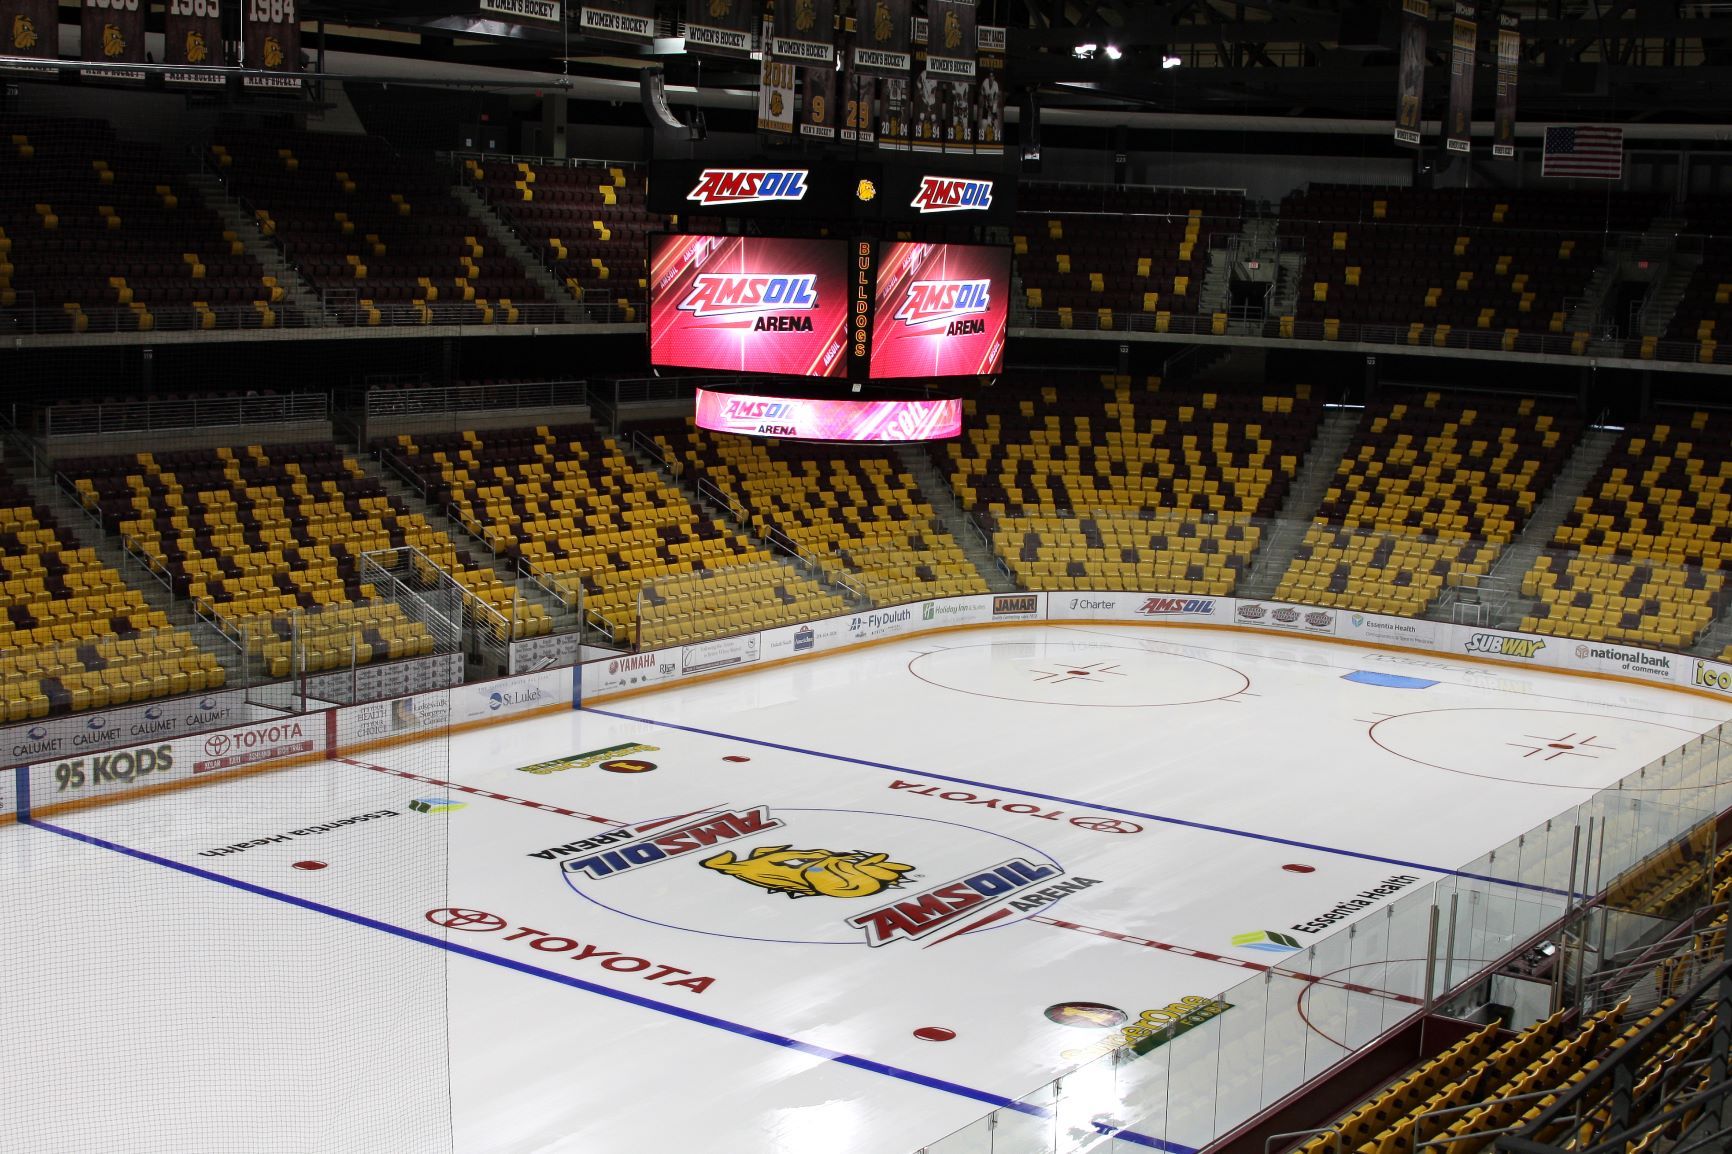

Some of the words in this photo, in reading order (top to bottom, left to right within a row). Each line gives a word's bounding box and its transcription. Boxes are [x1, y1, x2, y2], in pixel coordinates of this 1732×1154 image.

[249, 0, 295, 24] 1984
[524, 1, 555, 18] HOCKEY
[586, 11, 620, 28] WOMEN'S
[621, 16, 649, 33] HOCKEY
[689, 26, 721, 43] WOMEN'S
[721, 30, 746, 47] HOCKEY
[777, 40, 806, 57] WOMEN'S
[806, 42, 829, 58] HOCKEY
[858, 50, 883, 66] WOMEN'S
[883, 52, 906, 67] HOCKEY
[763, 61, 794, 89] 2011
[930, 58, 953, 72] WOMEN'S
[953, 60, 973, 74] HOCKEY
[812, 95, 825, 123] 9
[847, 100, 869, 128] 29
[690, 170, 807, 204] AMSOIL
[912, 176, 993, 212] AMSOIL
[659, 267, 679, 290] AMSOIL
[681, 275, 816, 315] AMSOIL
[855, 242, 870, 357] BULLDOGS
[896, 280, 991, 325] AMSOIL
[754, 316, 814, 332] ARENA
[946, 318, 985, 336] ARENA
[823, 341, 841, 366] AMSOIL
[758, 424, 797, 436] ARENA
[935, 603, 958, 614] Holiday
[958, 603, 969, 612] Inn
[995, 598, 1035, 611] JAMAR
[1079, 599, 1116, 610] Charter
[1138, 597, 1215, 616] AMSOIL
[1366, 621, 1394, 630] Essentia
[1465, 633, 1546, 658] SUBWAY
[619, 653, 656, 672] YAMAHA
[1590, 646, 1640, 664] national
[1640, 653, 1670, 669] bank
[1622, 662, 1630, 671] of
[1631, 665, 1669, 677] commerce
[503, 693, 514, 705] St.
[515, 687, 542, 704] Luke's
[130, 718, 177, 736] CALUMET
[186, 709, 231, 726] CALUMET
[357, 709, 387, 722] HEALTH
[12, 738, 62, 757] CALUMET
[73, 728, 121, 746] CALUMET
[233, 723, 303, 749] TOYOTA
[55, 758, 85, 792] 95
[92, 744, 173, 785] KQDS
[887, 779, 1065, 821] TOYOTA
[288, 809, 401, 836] Essentia
[198, 834, 293, 858] Health
[526, 829, 635, 860] ARENA
[563, 806, 783, 879] AMSOIL
[848, 858, 1061, 946] AMSOIL
[1008, 875, 1104, 914] ARENA
[1290, 898, 1374, 935] Essentia
[1356, 874, 1420, 900] Health
[503, 926, 716, 994] TOYOTA
